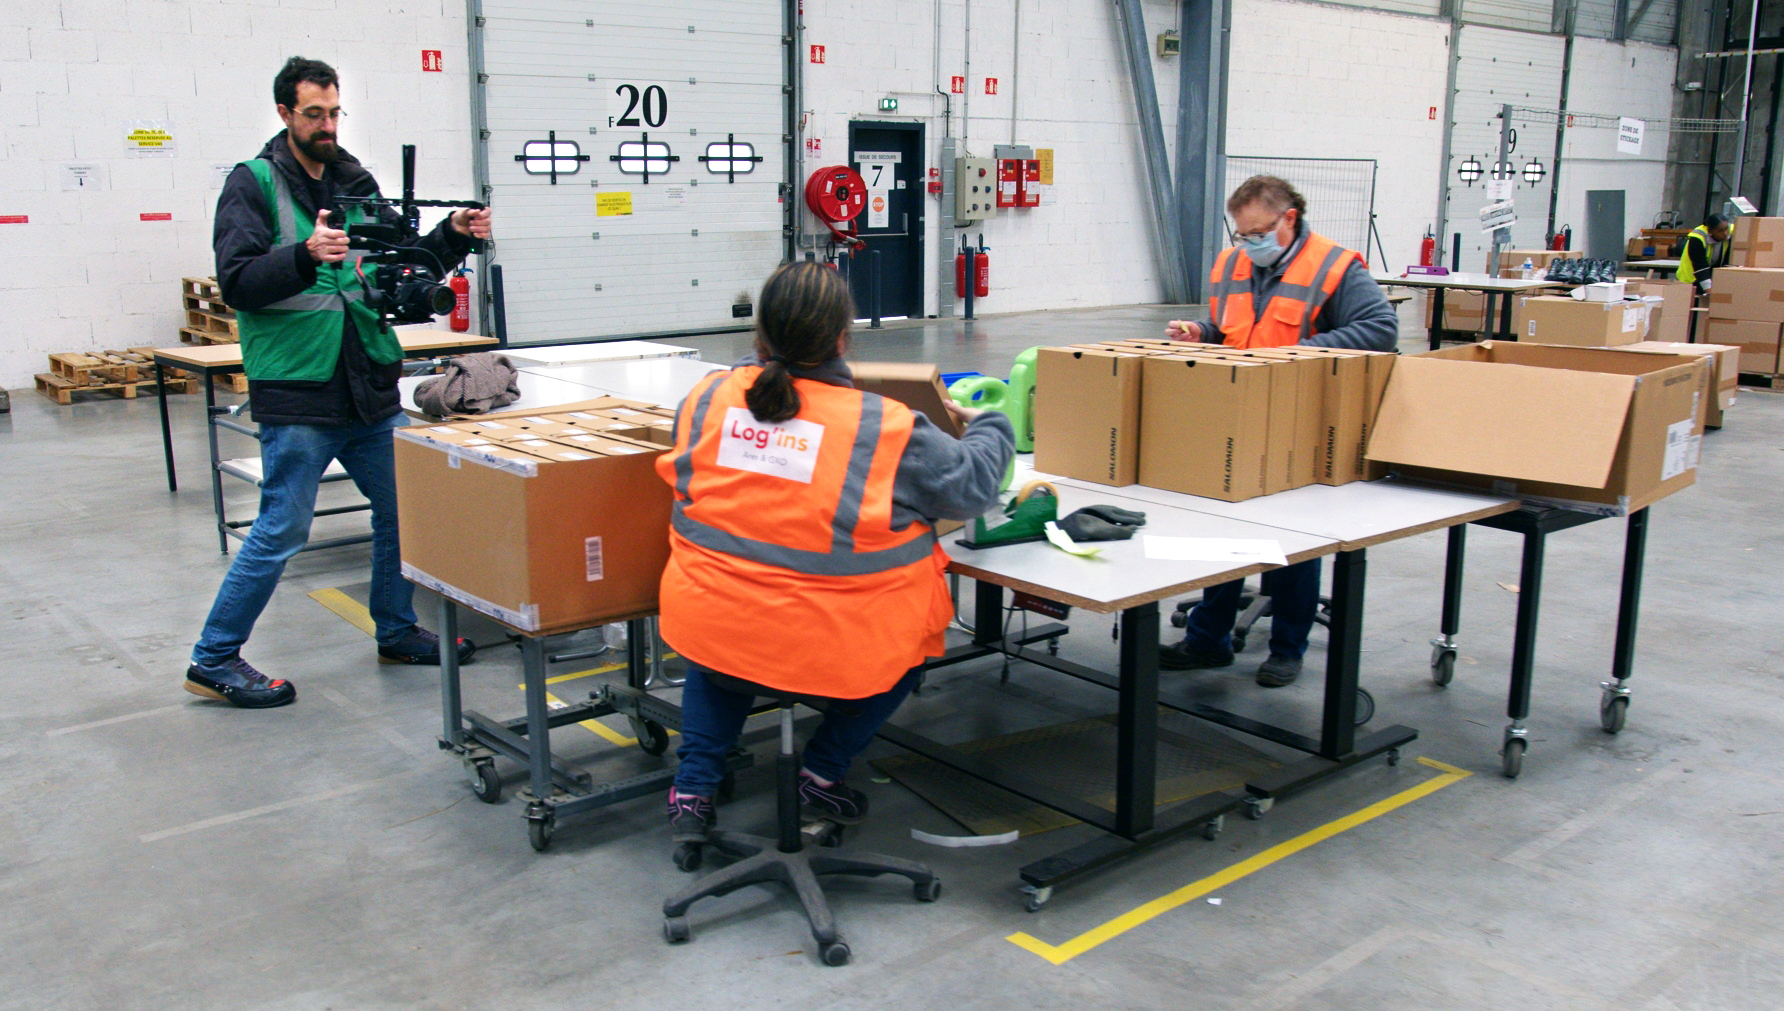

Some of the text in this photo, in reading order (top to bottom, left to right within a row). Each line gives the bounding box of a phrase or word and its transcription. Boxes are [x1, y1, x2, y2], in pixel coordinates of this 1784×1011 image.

[608, 83, 668, 128] F 20
[872, 165, 884, 187] 7
[731, 419, 808, 452] Log'ins
[1108, 427, 1117, 480] SALOMON
[1324, 425, 1335, 479] SALOMON
[1223, 437, 1234, 493] SALOMON
